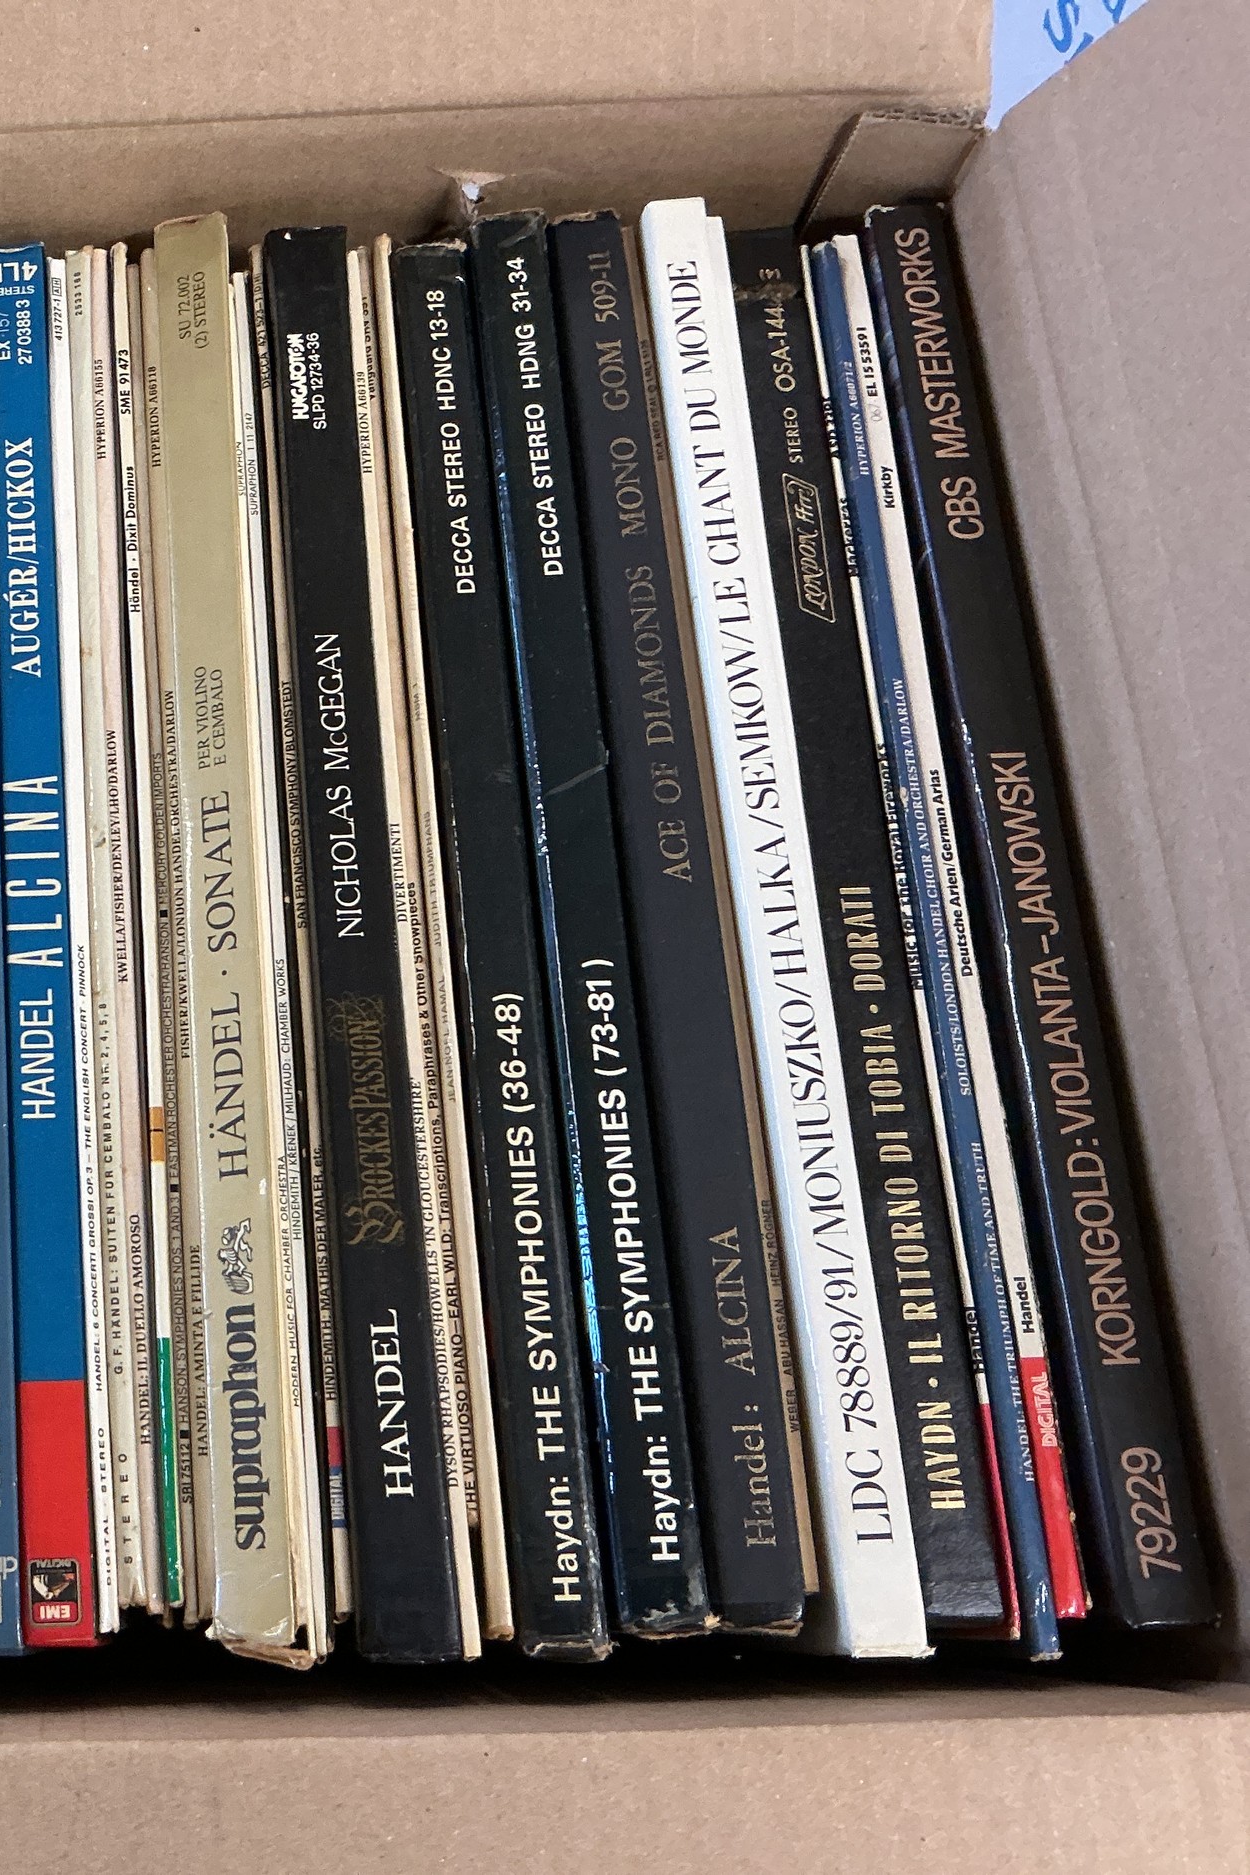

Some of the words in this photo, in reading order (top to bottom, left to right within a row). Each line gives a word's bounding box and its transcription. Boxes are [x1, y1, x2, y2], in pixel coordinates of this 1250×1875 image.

[190, 271, 209, 327] STEREO
[426, 289, 449, 340] 13-18
[506, 257, 531, 312] 31-34
[585, 251, 620, 322] 509-11
[664, 260, 715, 374] MONDE
[177, 318, 192, 339] SU
[193, 330, 209, 348] (2)
[306, 331, 325, 390] 12734-36
[514, 323, 541, 388] HDNG
[892, 227, 973, 458] MASTERWORKS
[118, 389, 132, 414] SME
[432, 346, 457, 410] HDNC
[595, 339, 631, 410] GOM
[683, 386, 722, 430] DU
[93, 399, 109, 459] HYPERION
[147, 406, 163, 467] HYPERION
[311, 393, 327, 429] SLPD
[356, 411, 374, 473] HYPERION
[523, 403, 553, 488] STEREO
[781, 406, 805, 463] STEREO
[848, 412, 871, 475] HYPERION
[121, 466, 137, 518] Dominus
[440, 422, 467, 507] STEREO
[607, 436, 649, 536] MONO
[878, 465, 899, 508] Kirkby
[534, 496, 564, 575] DECCA
[691, 443, 743, 565] CHANT
[938, 476, 986, 539] CBS
[449, 516, 477, 593] DECCA
[793, 526, 831, 610] LONDON
[623, 565, 677, 744] DIAMONDS
[191, 665, 211, 734] VIOLINO
[207, 668, 228, 750] CEMBALO
[312, 632, 352, 770] McGEGAN
[195, 738, 212, 769] PER
[212, 754, 227, 765] E
[649, 761, 682, 803] OF
[197, 790, 241, 952] SONATE
[325, 784, 365, 938] NICHOLAS
[656, 819, 694, 883] ACE
[916, 821, 931, 851] AND
[0, 775, 66, 969] ALCINA
[388, 822, 409, 922] DIVERTIMENTI
[921, 854, 939, 897] CHOIR
[837, 885, 887, 991] DORATI
[928, 900, 949, 957] HANDEL
[949, 909, 974, 976] Deutsche
[17, 988, 58, 1119] HANDEL
[199, 991, 254, 1180] HÄNDEL
[490, 991, 535, 1113] (36-48)
[858, 1023, 907, 1116] TOBIA
[875, 1131, 913, 1162] DI
[313, 1224, 328, 1253] DER
[595, 1089, 656, 1333] SYMPHONIES
[129, 1213, 145, 1288] AMOROSO
[503, 1126, 559, 1371] SYMPHONIES
[881, 1176, 940, 1319] RITORNO
[132, 1293, 148, 1353] DUELLO
[706, 1226, 758, 1375] ALCINA
[1013, 1276, 1036, 1333] Handel
[626, 1345, 666, 1421] THE
[905, 1332, 945, 1364] IL
[216, 1303, 276, 1550] supraphon
[368, 1308, 415, 1498] HANDEL
[531, 1385, 567, 1460] THE
[914, 1399, 967, 1508] HAYDN
[637, 1434, 687, 1561] Haydn:
[843, 1448, 895, 1543] LDC
[1117, 1445, 1184, 1577] 79229
[540, 1475, 589, 1602] Haydn:
[39, 1604, 70, 1619] EMI
